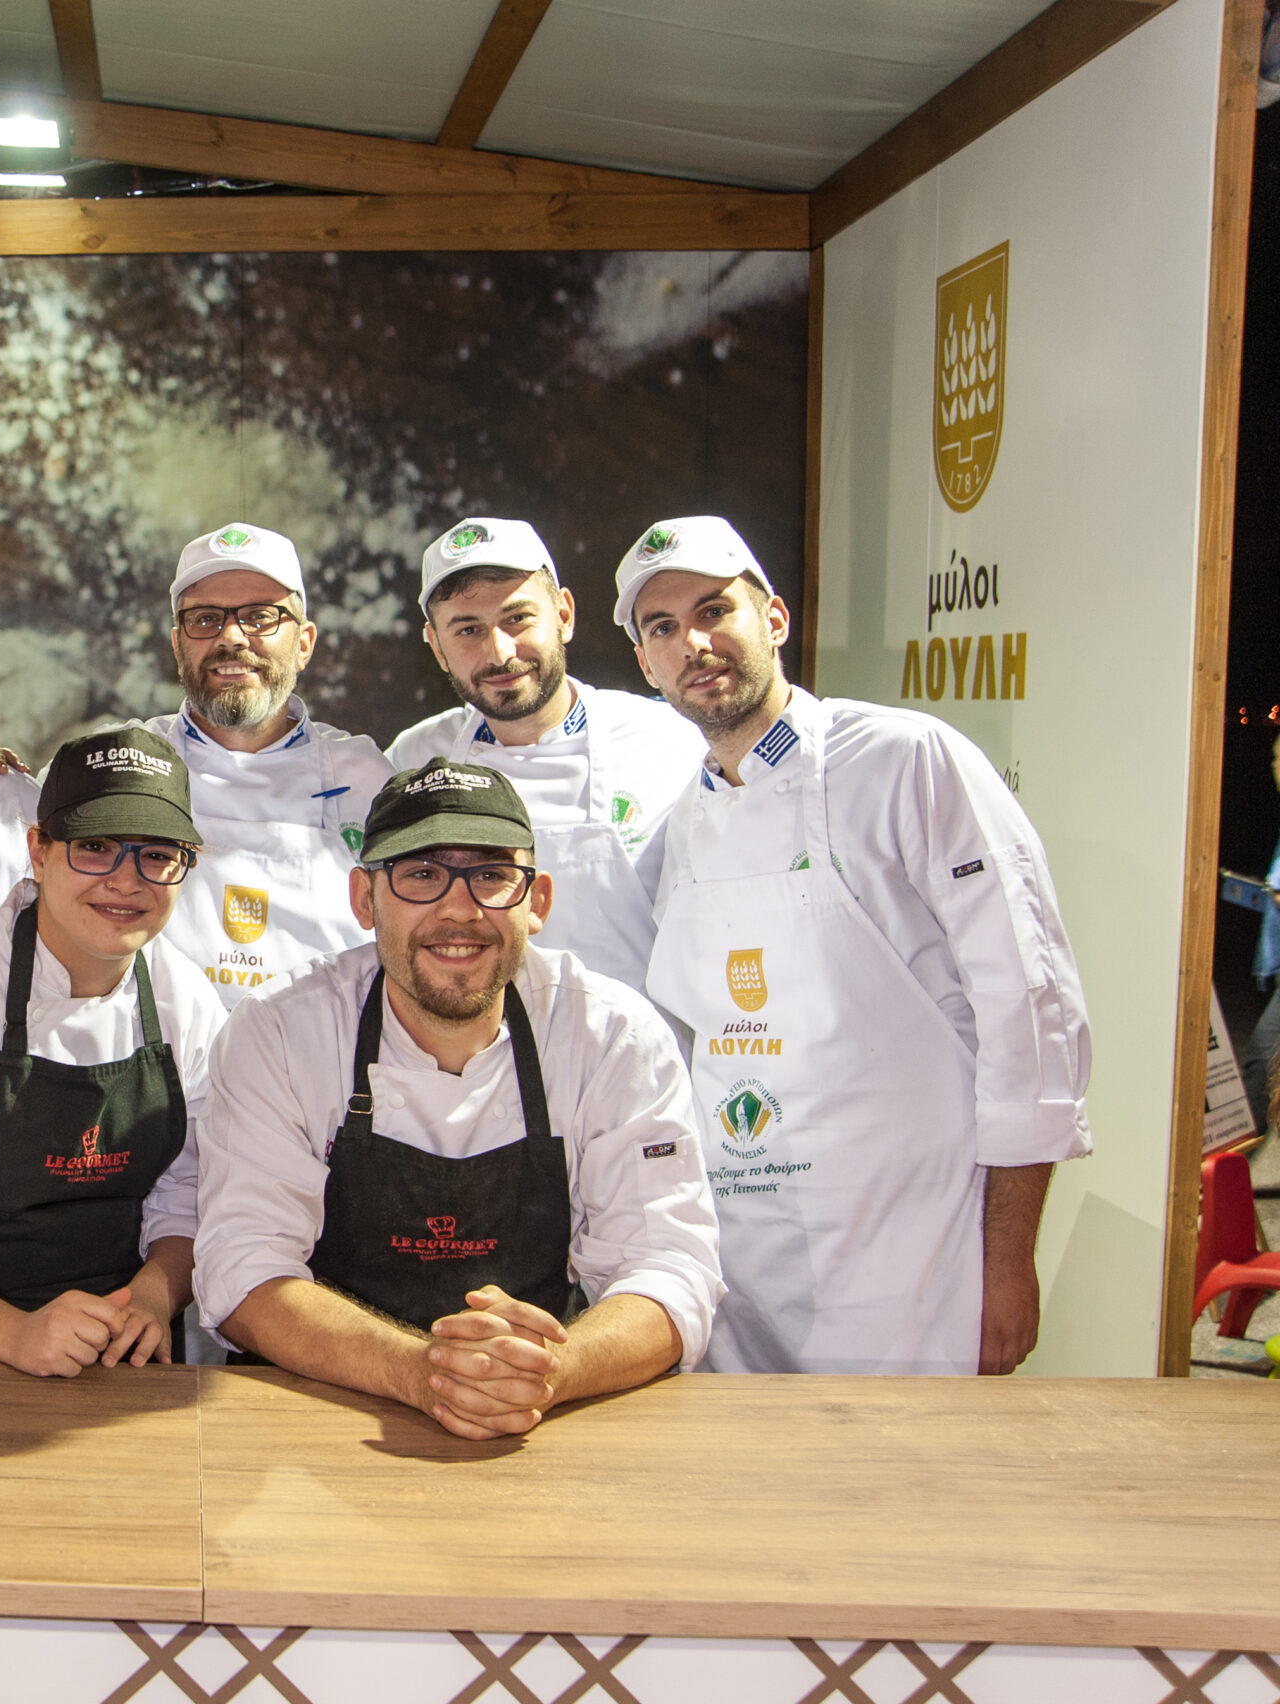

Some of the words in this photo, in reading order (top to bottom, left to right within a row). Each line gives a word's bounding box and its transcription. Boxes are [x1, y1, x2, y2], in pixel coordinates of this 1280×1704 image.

[949, 463, 982, 494] 1782
[928, 548, 999, 633] μύλοι
[900, 632, 1028, 702] ΛΟΥΛΗ
[86, 750, 105, 766] LE
[404, 779, 423, 793] LE
[219, 949, 264, 967] μύλοι
[722, 1019, 768, 1036] μύλοι
[708, 1038, 783, 1056] ΛΟΥΛΗ
[720, 1140, 768, 1160] ΜΑΓΝΗΣΙΑΣ
[44, 1154, 66, 1168] LE
[66, 1151, 131, 1169] GOURMET
[749, 1167, 762, 1176] το
[764, 1161, 812, 1176] Φούρνο
[715, 1186, 731, 1198] της
[733, 1180, 781, 1194] Γειτονιάς
[391, 1235, 412, 1247] LE
[415, 1238, 498, 1250] GOURMET
